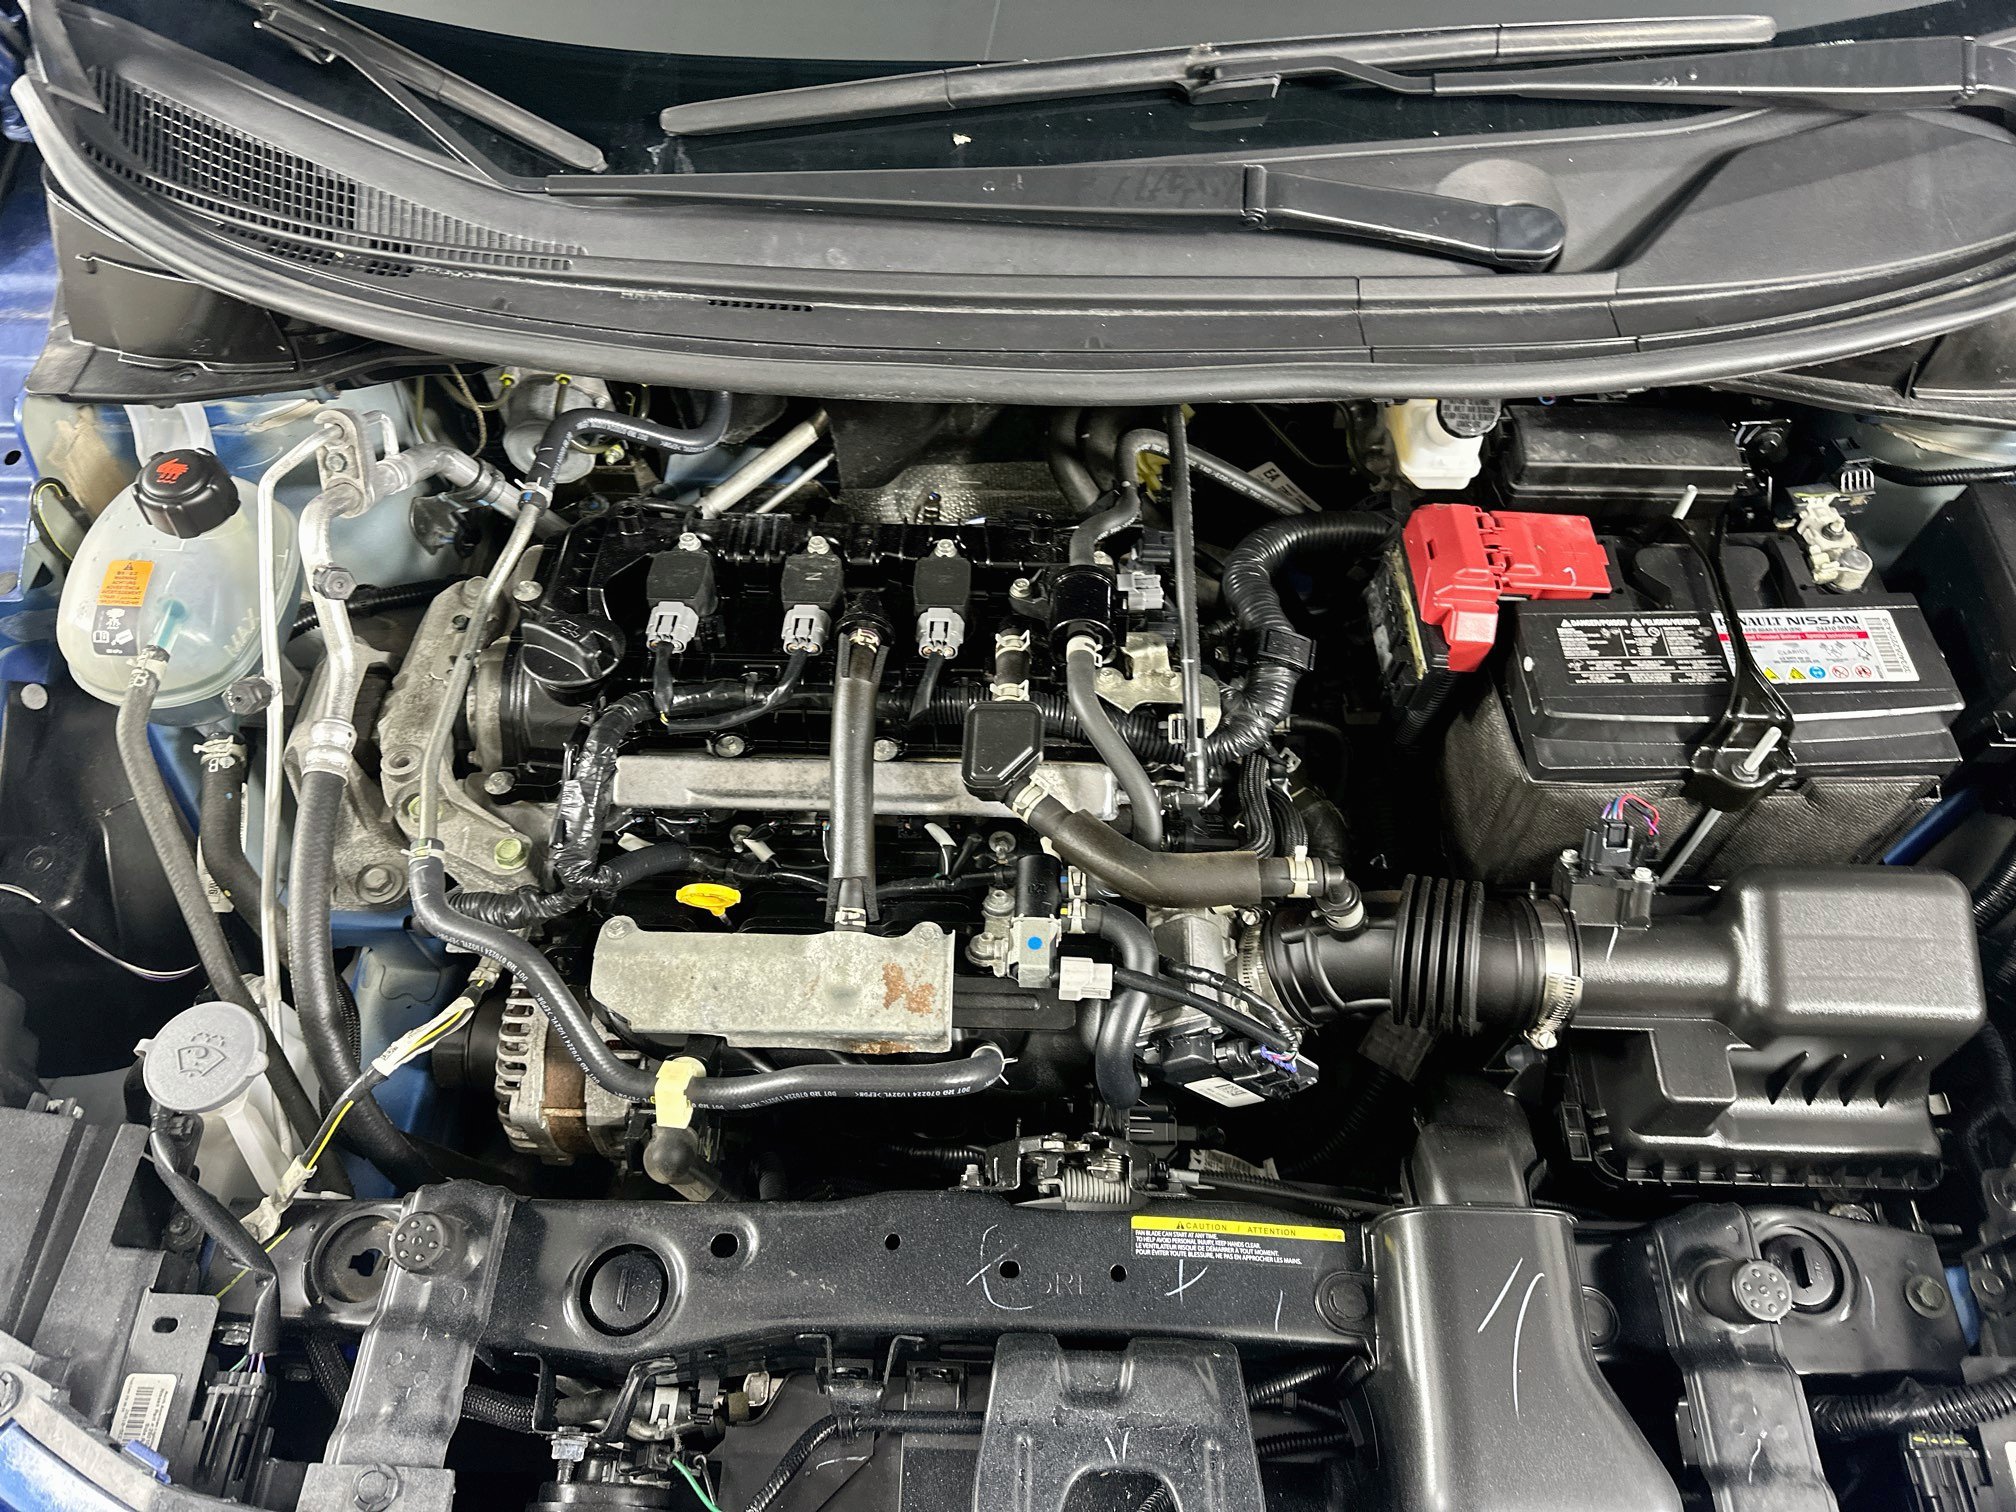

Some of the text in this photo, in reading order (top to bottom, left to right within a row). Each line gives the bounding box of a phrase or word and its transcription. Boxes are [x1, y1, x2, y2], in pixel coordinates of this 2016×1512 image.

[1263, 468, 1280, 482] EA
[1788, 616, 1858, 625] NISSAN
[566, 1040, 582, 1062] 070224
[1186, 1222, 1227, 1231] CAUTION
[1248, 1226, 1296, 1236] ATTENTION
